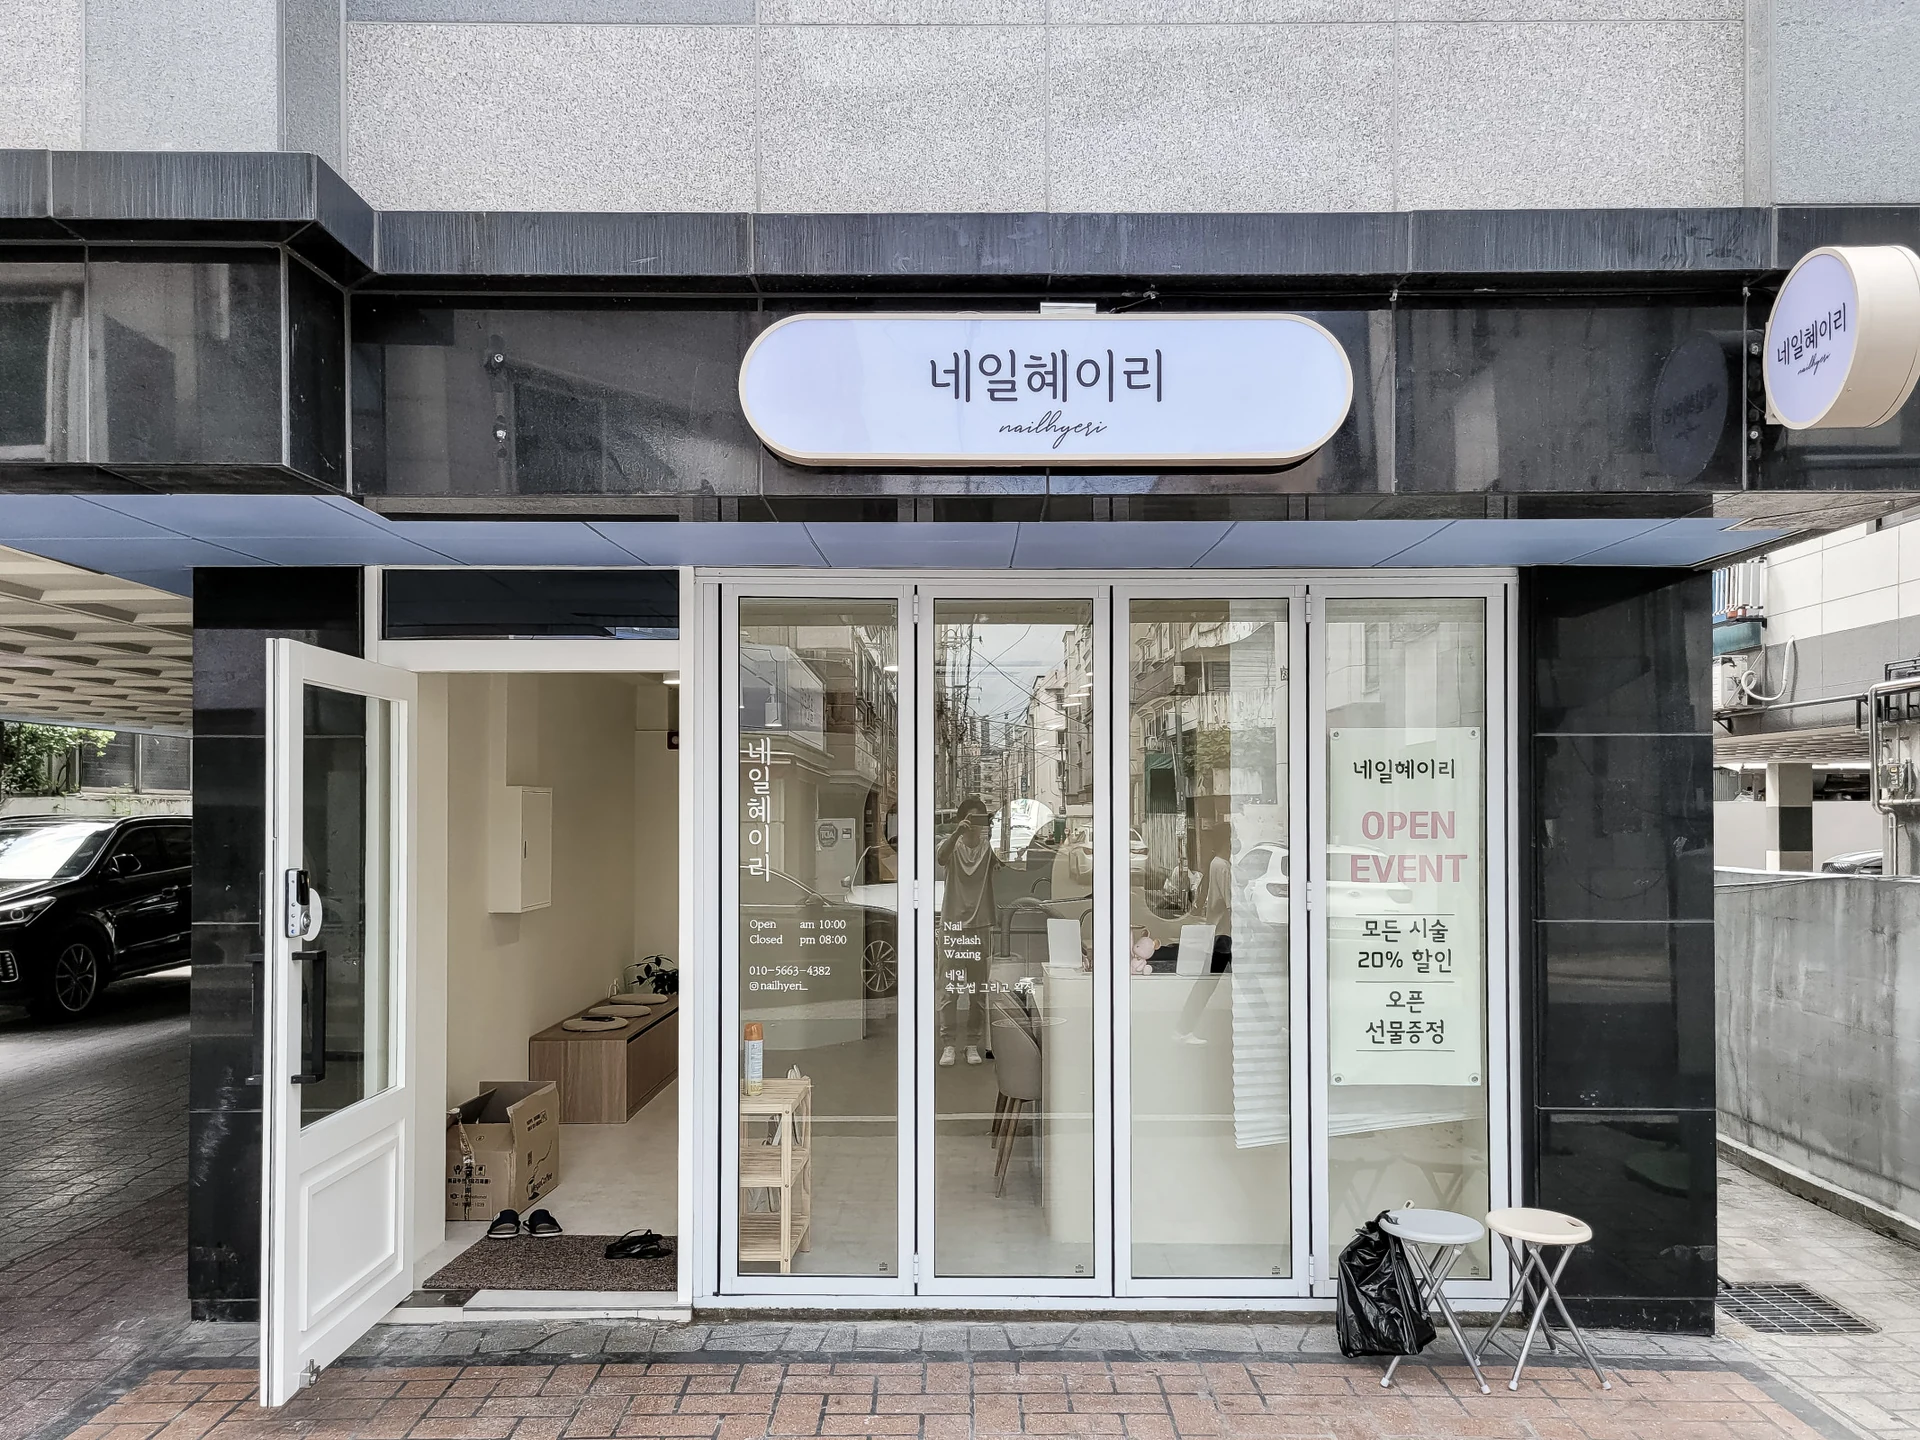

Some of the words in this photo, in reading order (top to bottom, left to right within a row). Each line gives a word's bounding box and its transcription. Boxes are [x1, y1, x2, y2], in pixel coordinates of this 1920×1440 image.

[929, 348, 1164, 404] 네일혜이리
[1361, 810, 1455, 840] OPEN
[1350, 854, 1468, 883] EVENT
[749, 919, 777, 931] Open
[799, 921, 815, 929] am
[819, 919, 847, 929] 10:00
[943, 921, 963, 931] Nail
[1362, 919, 1401, 942] 모든
[1409, 918, 1449, 942] 시술
[749, 934, 783, 944] Closed
[799, 936, 816, 946] pm
[819, 934, 847, 944] 08:00
[943, 935, 981, 947] Eyelash
[944, 949, 981, 960] Waxing
[1358, 951, 1404, 968] 20%
[1412, 948, 1452, 973] 할인
[749, 965, 831, 976] 010-5663-4382
[945, 969, 965, 981] 네일
[945, 982, 976, 994] 속눈썹
[980, 982, 1010, 993] 그리고
[1385, 990, 1425, 1013] 오픈
[1365, 1019, 1445, 1045] 선물증정
